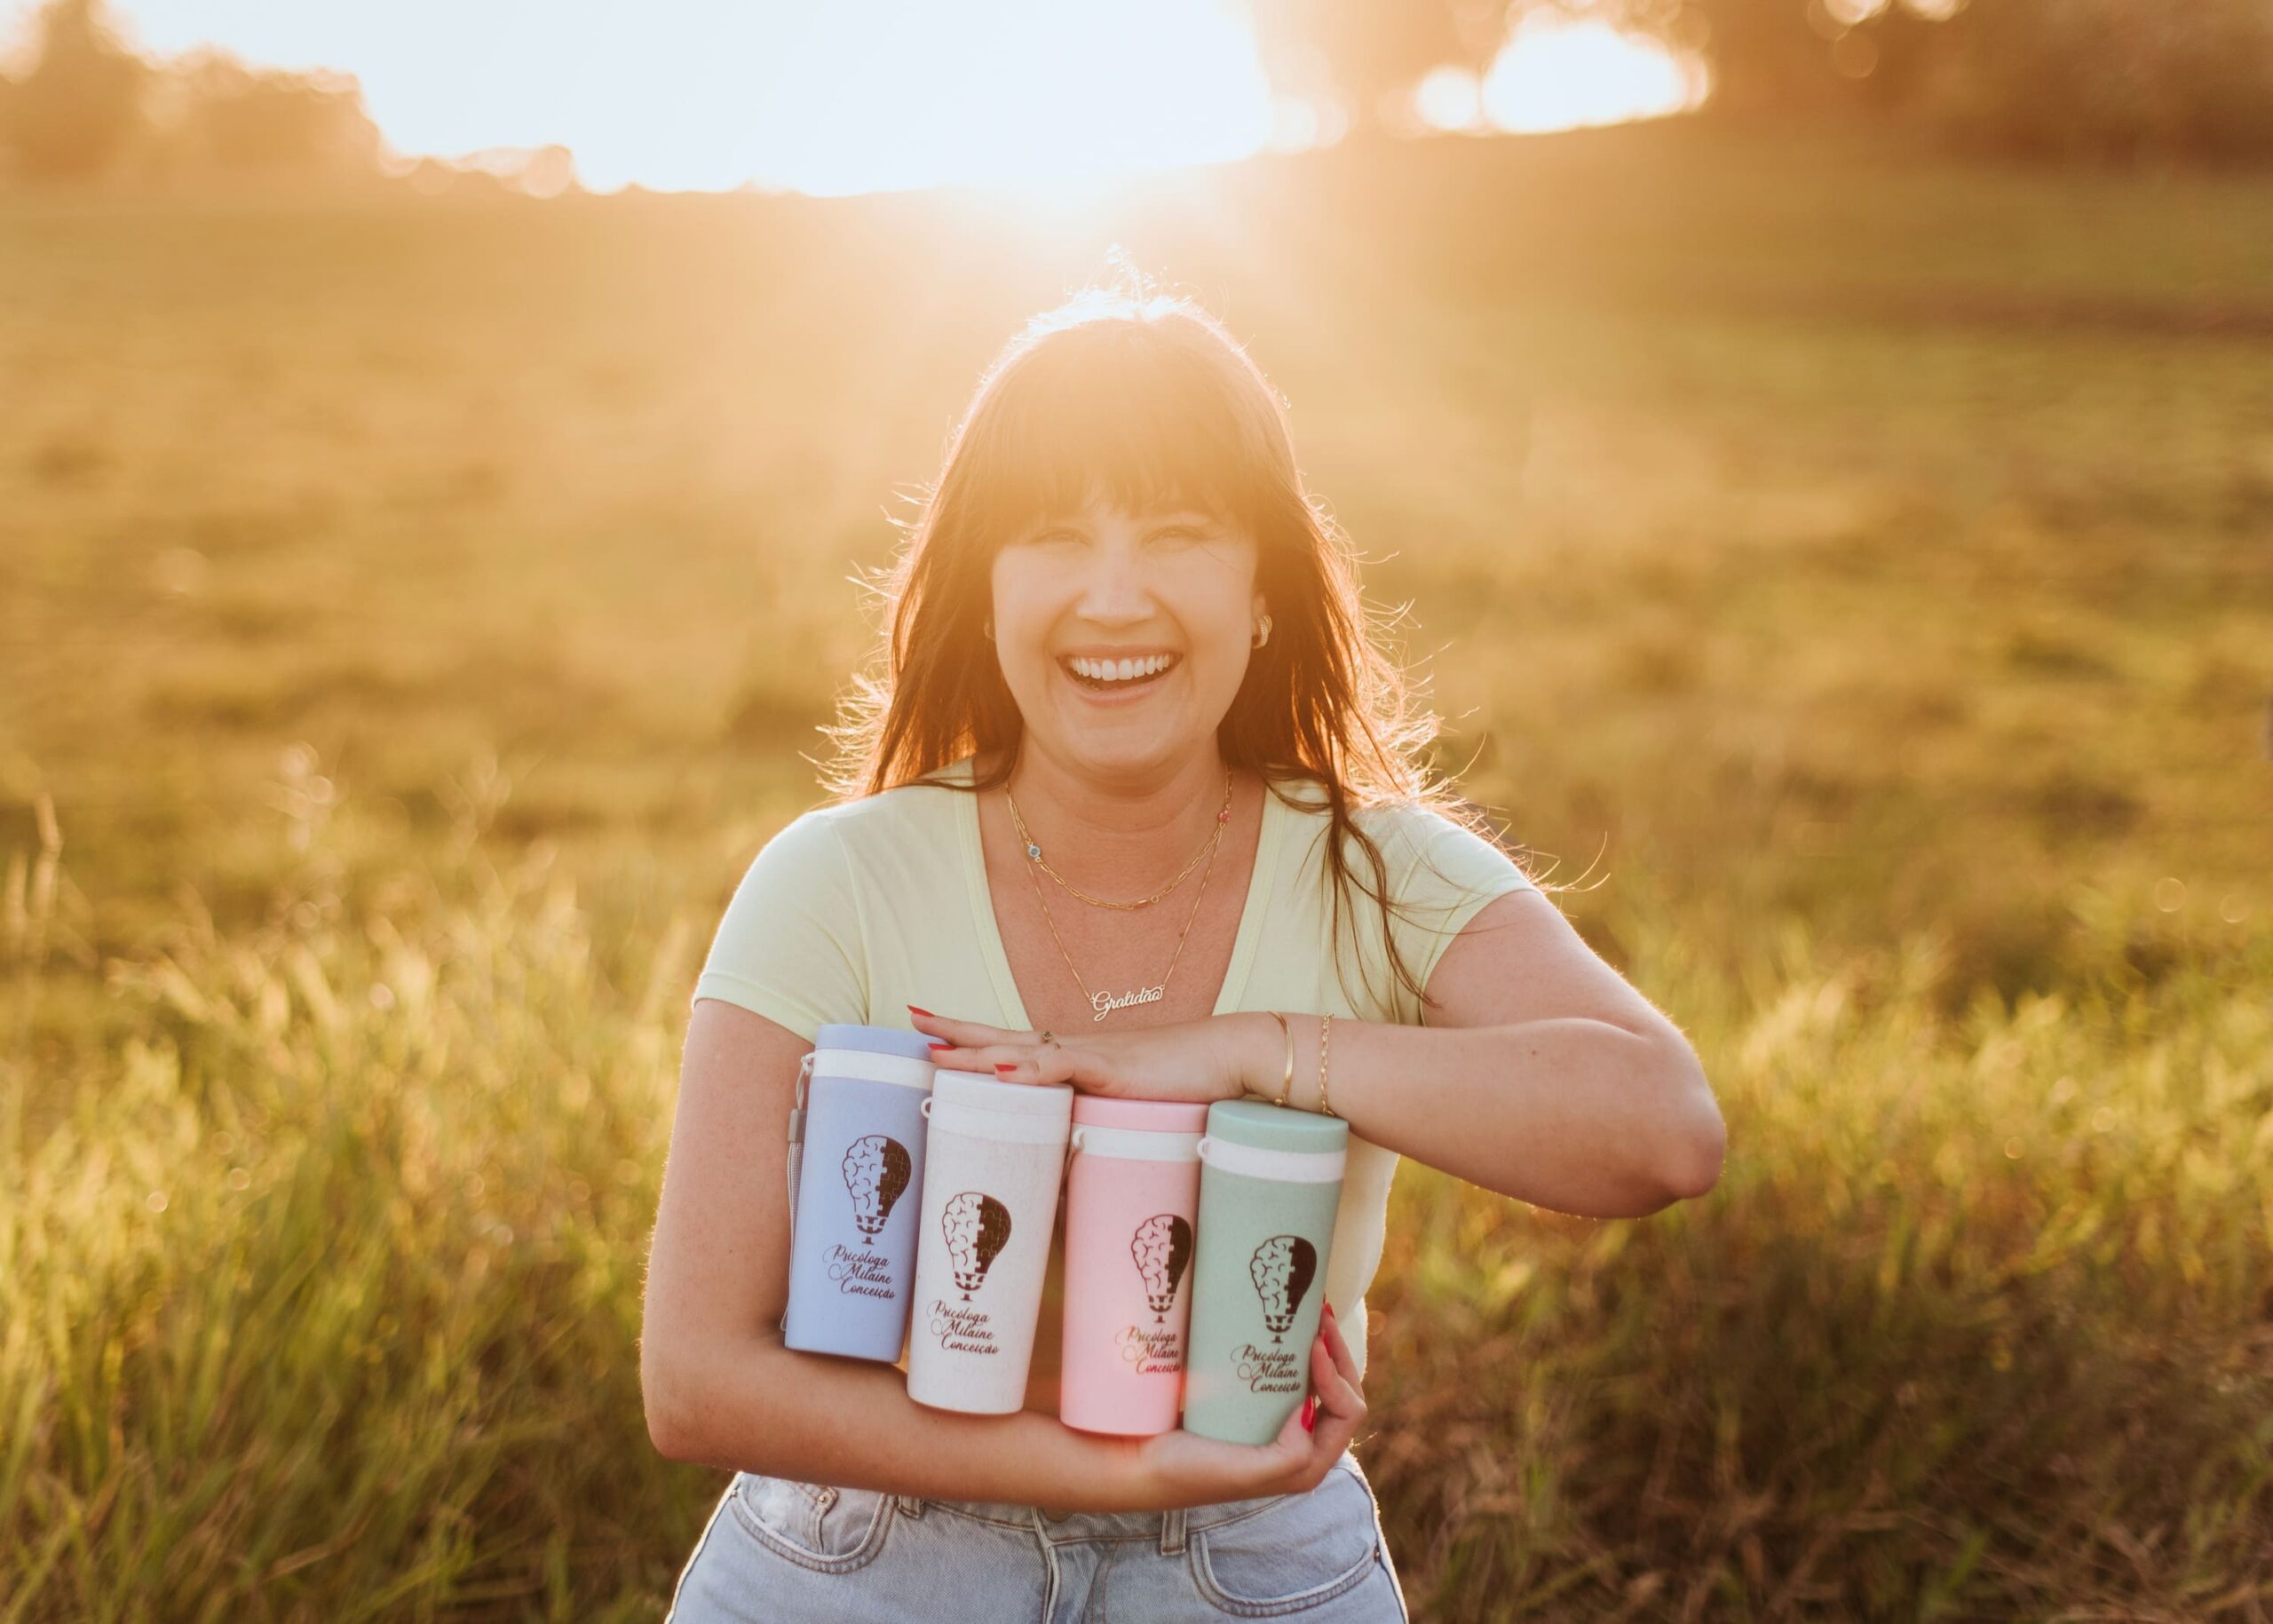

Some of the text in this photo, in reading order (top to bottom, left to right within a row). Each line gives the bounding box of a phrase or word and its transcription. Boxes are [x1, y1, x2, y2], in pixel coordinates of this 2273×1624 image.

[1091, 986, 1164, 1022] Gratidão
[828, 1263, 892, 1285] Milaine
[931, 1319, 994, 1340] Milaine
